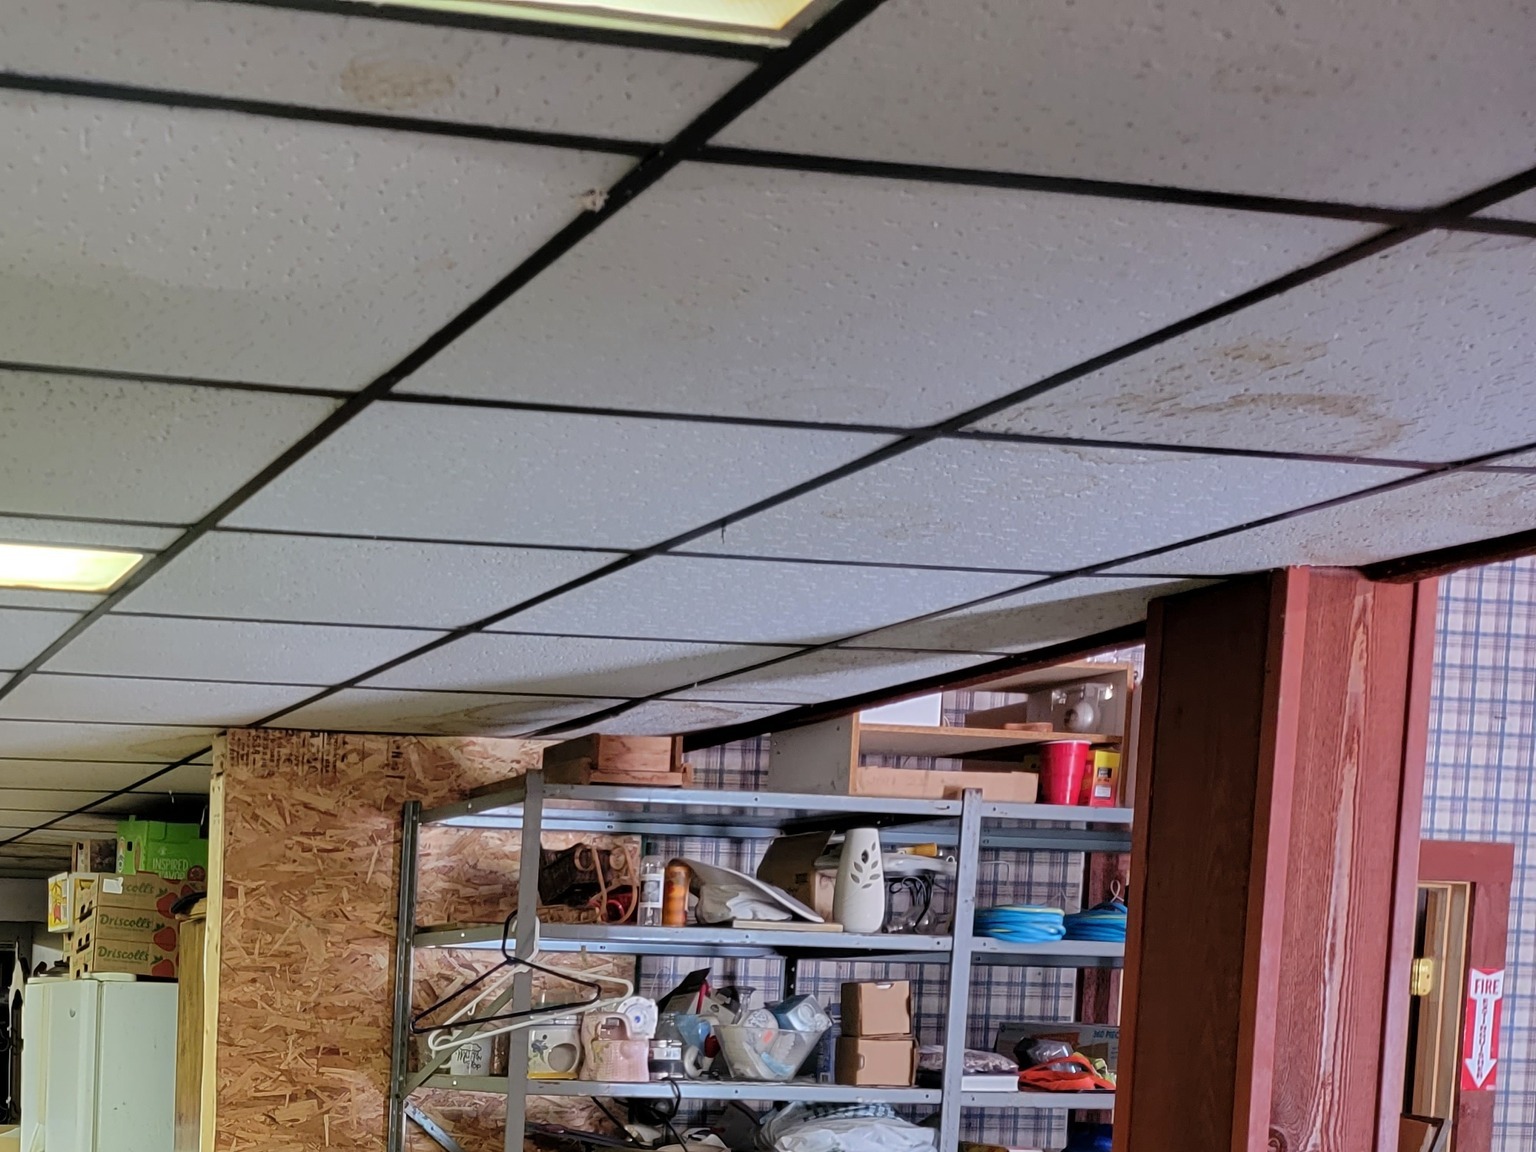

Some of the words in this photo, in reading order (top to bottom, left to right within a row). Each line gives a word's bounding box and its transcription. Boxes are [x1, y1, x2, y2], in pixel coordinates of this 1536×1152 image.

[153, 859, 188, 871] INSPIRED
[100, 914, 152, 928] Driscoll's
[98, 946, 149, 961] Driscoll's
[1474, 979, 1500, 994] FIRE
[1106, 1030, 1120, 1039] PIEC
